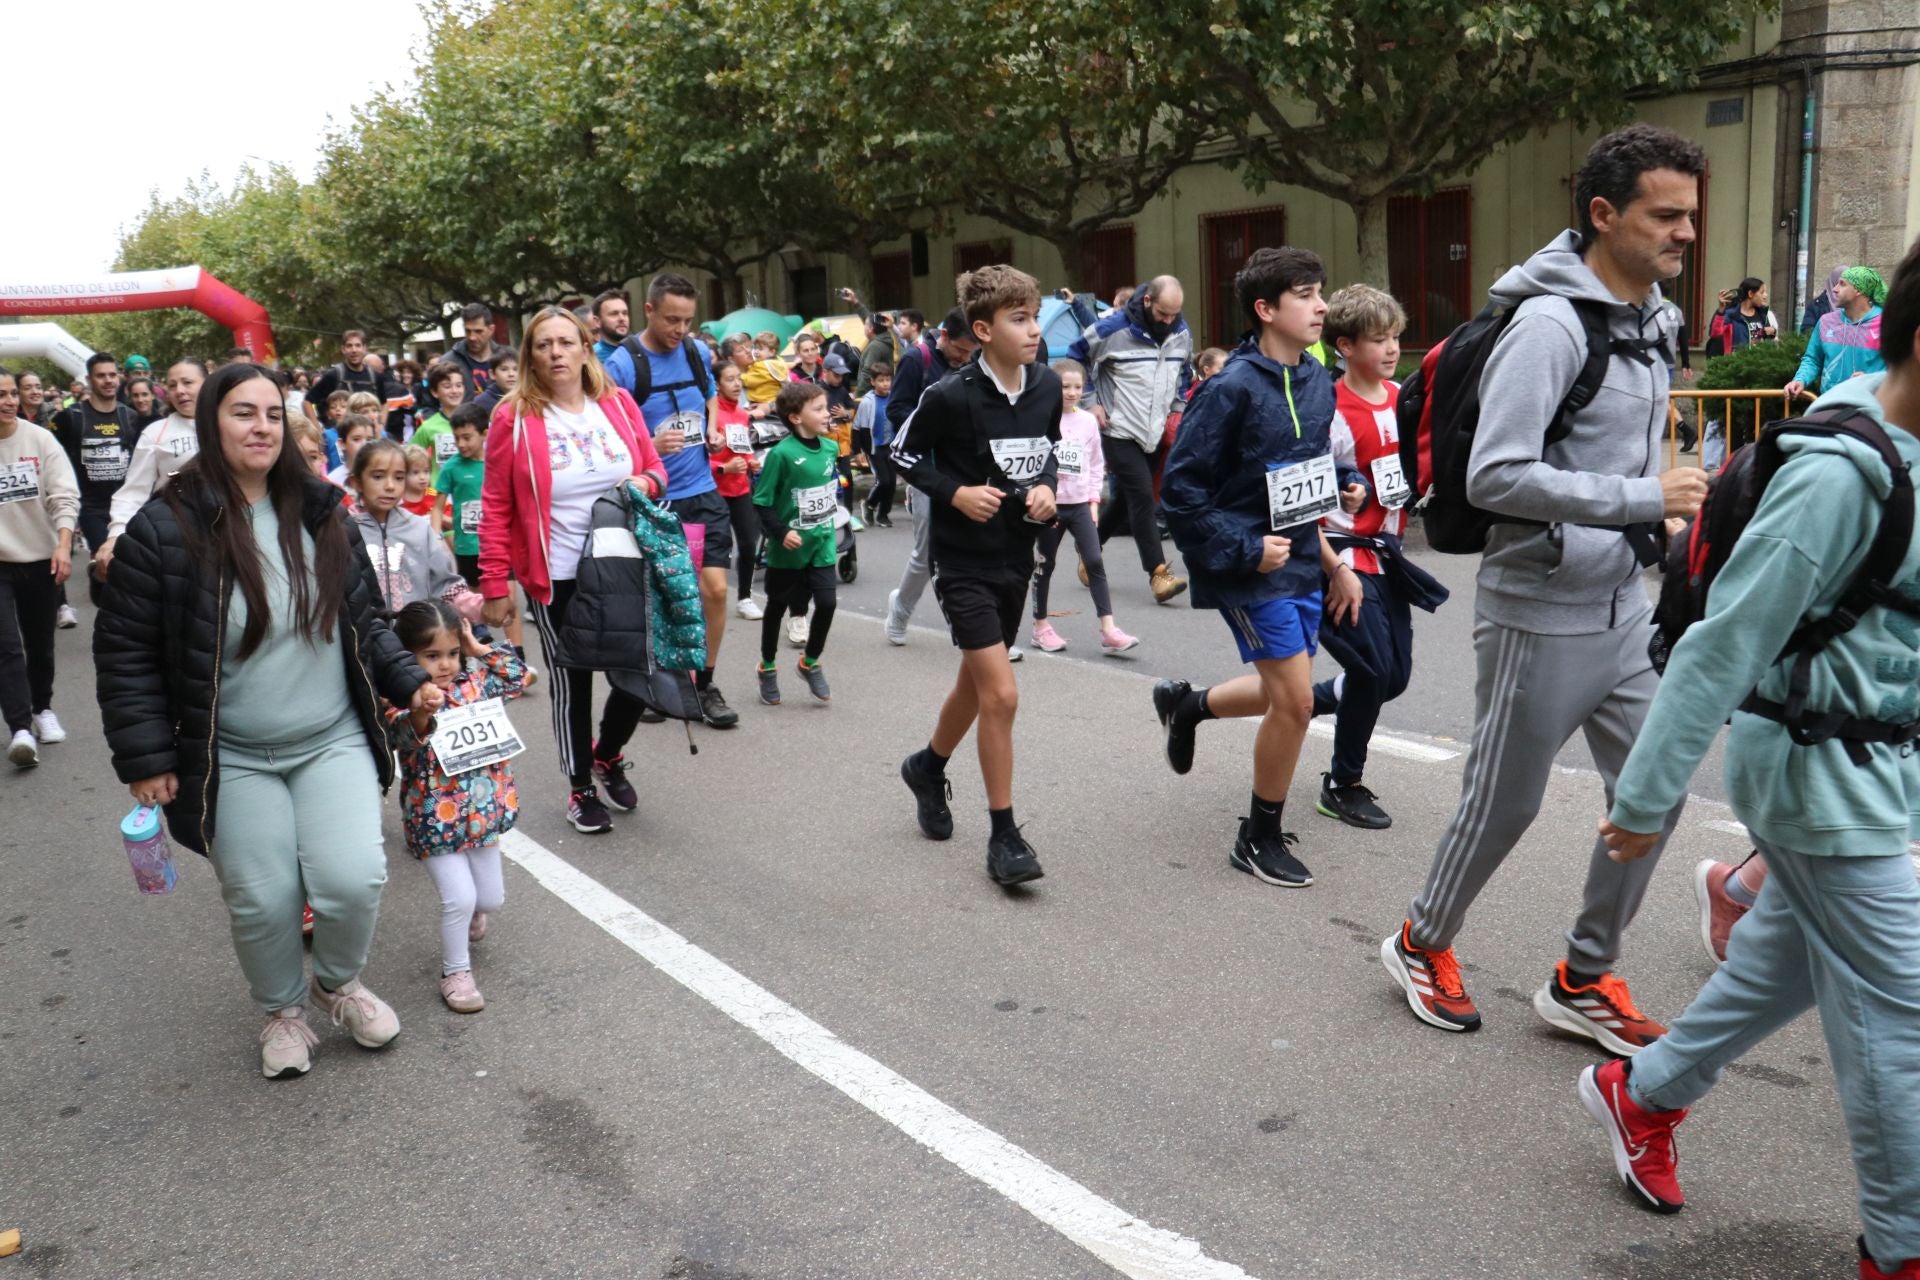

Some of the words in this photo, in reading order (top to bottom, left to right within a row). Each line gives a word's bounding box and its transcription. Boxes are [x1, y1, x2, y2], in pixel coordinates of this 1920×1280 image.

[88, 283, 106, 293] DE
[79, 296, 125, 306] DEPORTES
[1003, 453, 1044, 476] 2708
[1280, 475, 1325, 506] 2717
[1384, 470, 1408, 491] 27
[444, 720, 499, 751] 2031
